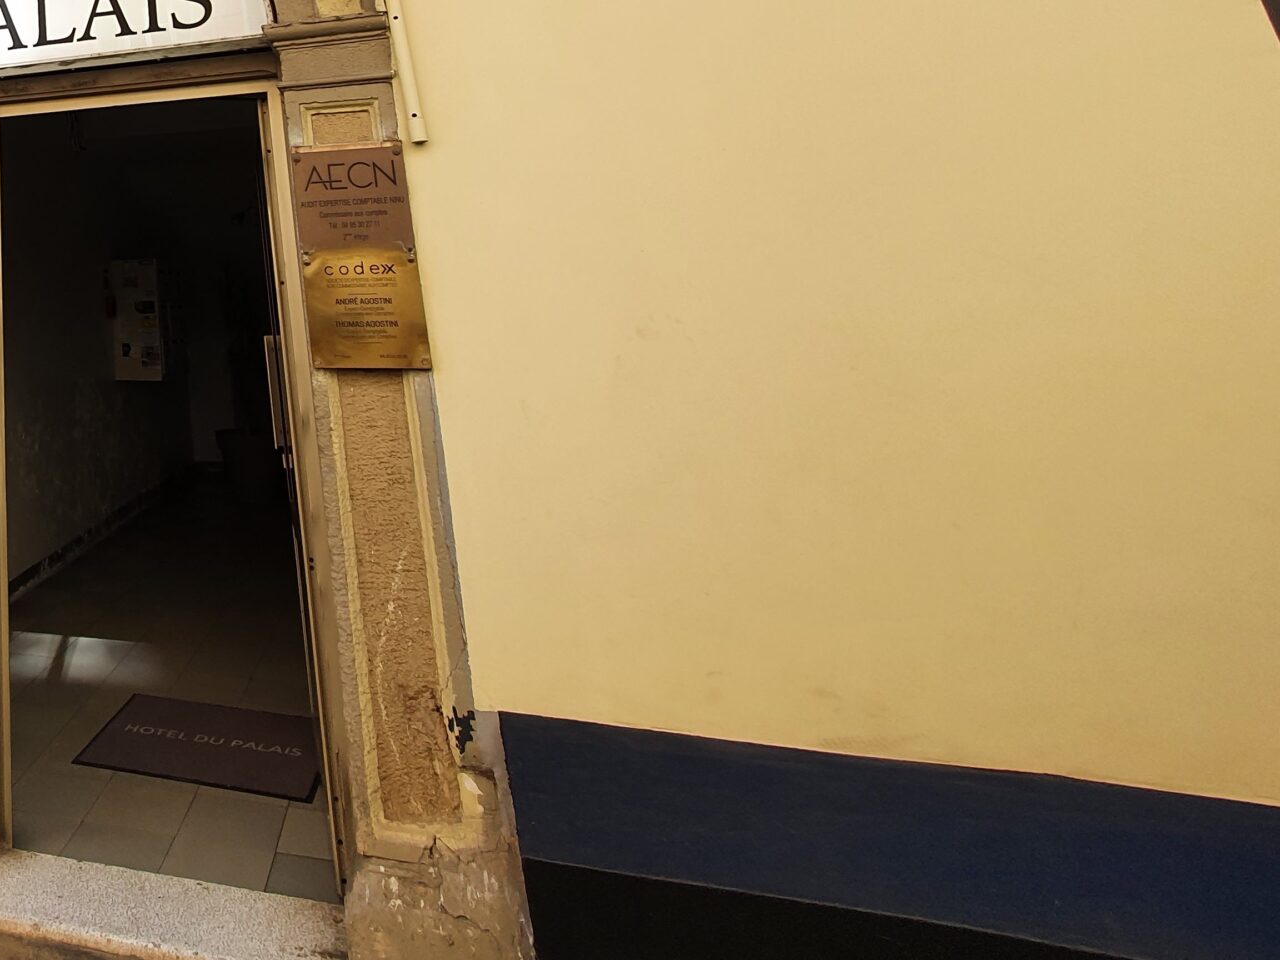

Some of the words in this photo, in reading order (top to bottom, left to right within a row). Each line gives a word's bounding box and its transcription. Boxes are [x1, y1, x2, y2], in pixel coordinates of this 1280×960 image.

[304, 159, 398, 192] AECN
[300, 200, 318, 209] AUDIT
[319, 199, 352, 208] EXPERTISE
[352, 197, 387, 206] COMPTABLE
[336, 297, 358, 305] ANDRÉ
[360, 297, 393, 305] AGOSTINI
[336, 320, 365, 328] THOMAS
[365, 320, 399, 328] AGOSTINI
[124, 723, 187, 741] HOTEL
[194, 734, 225, 746] DU
[230, 739, 303, 757] PALAIS
